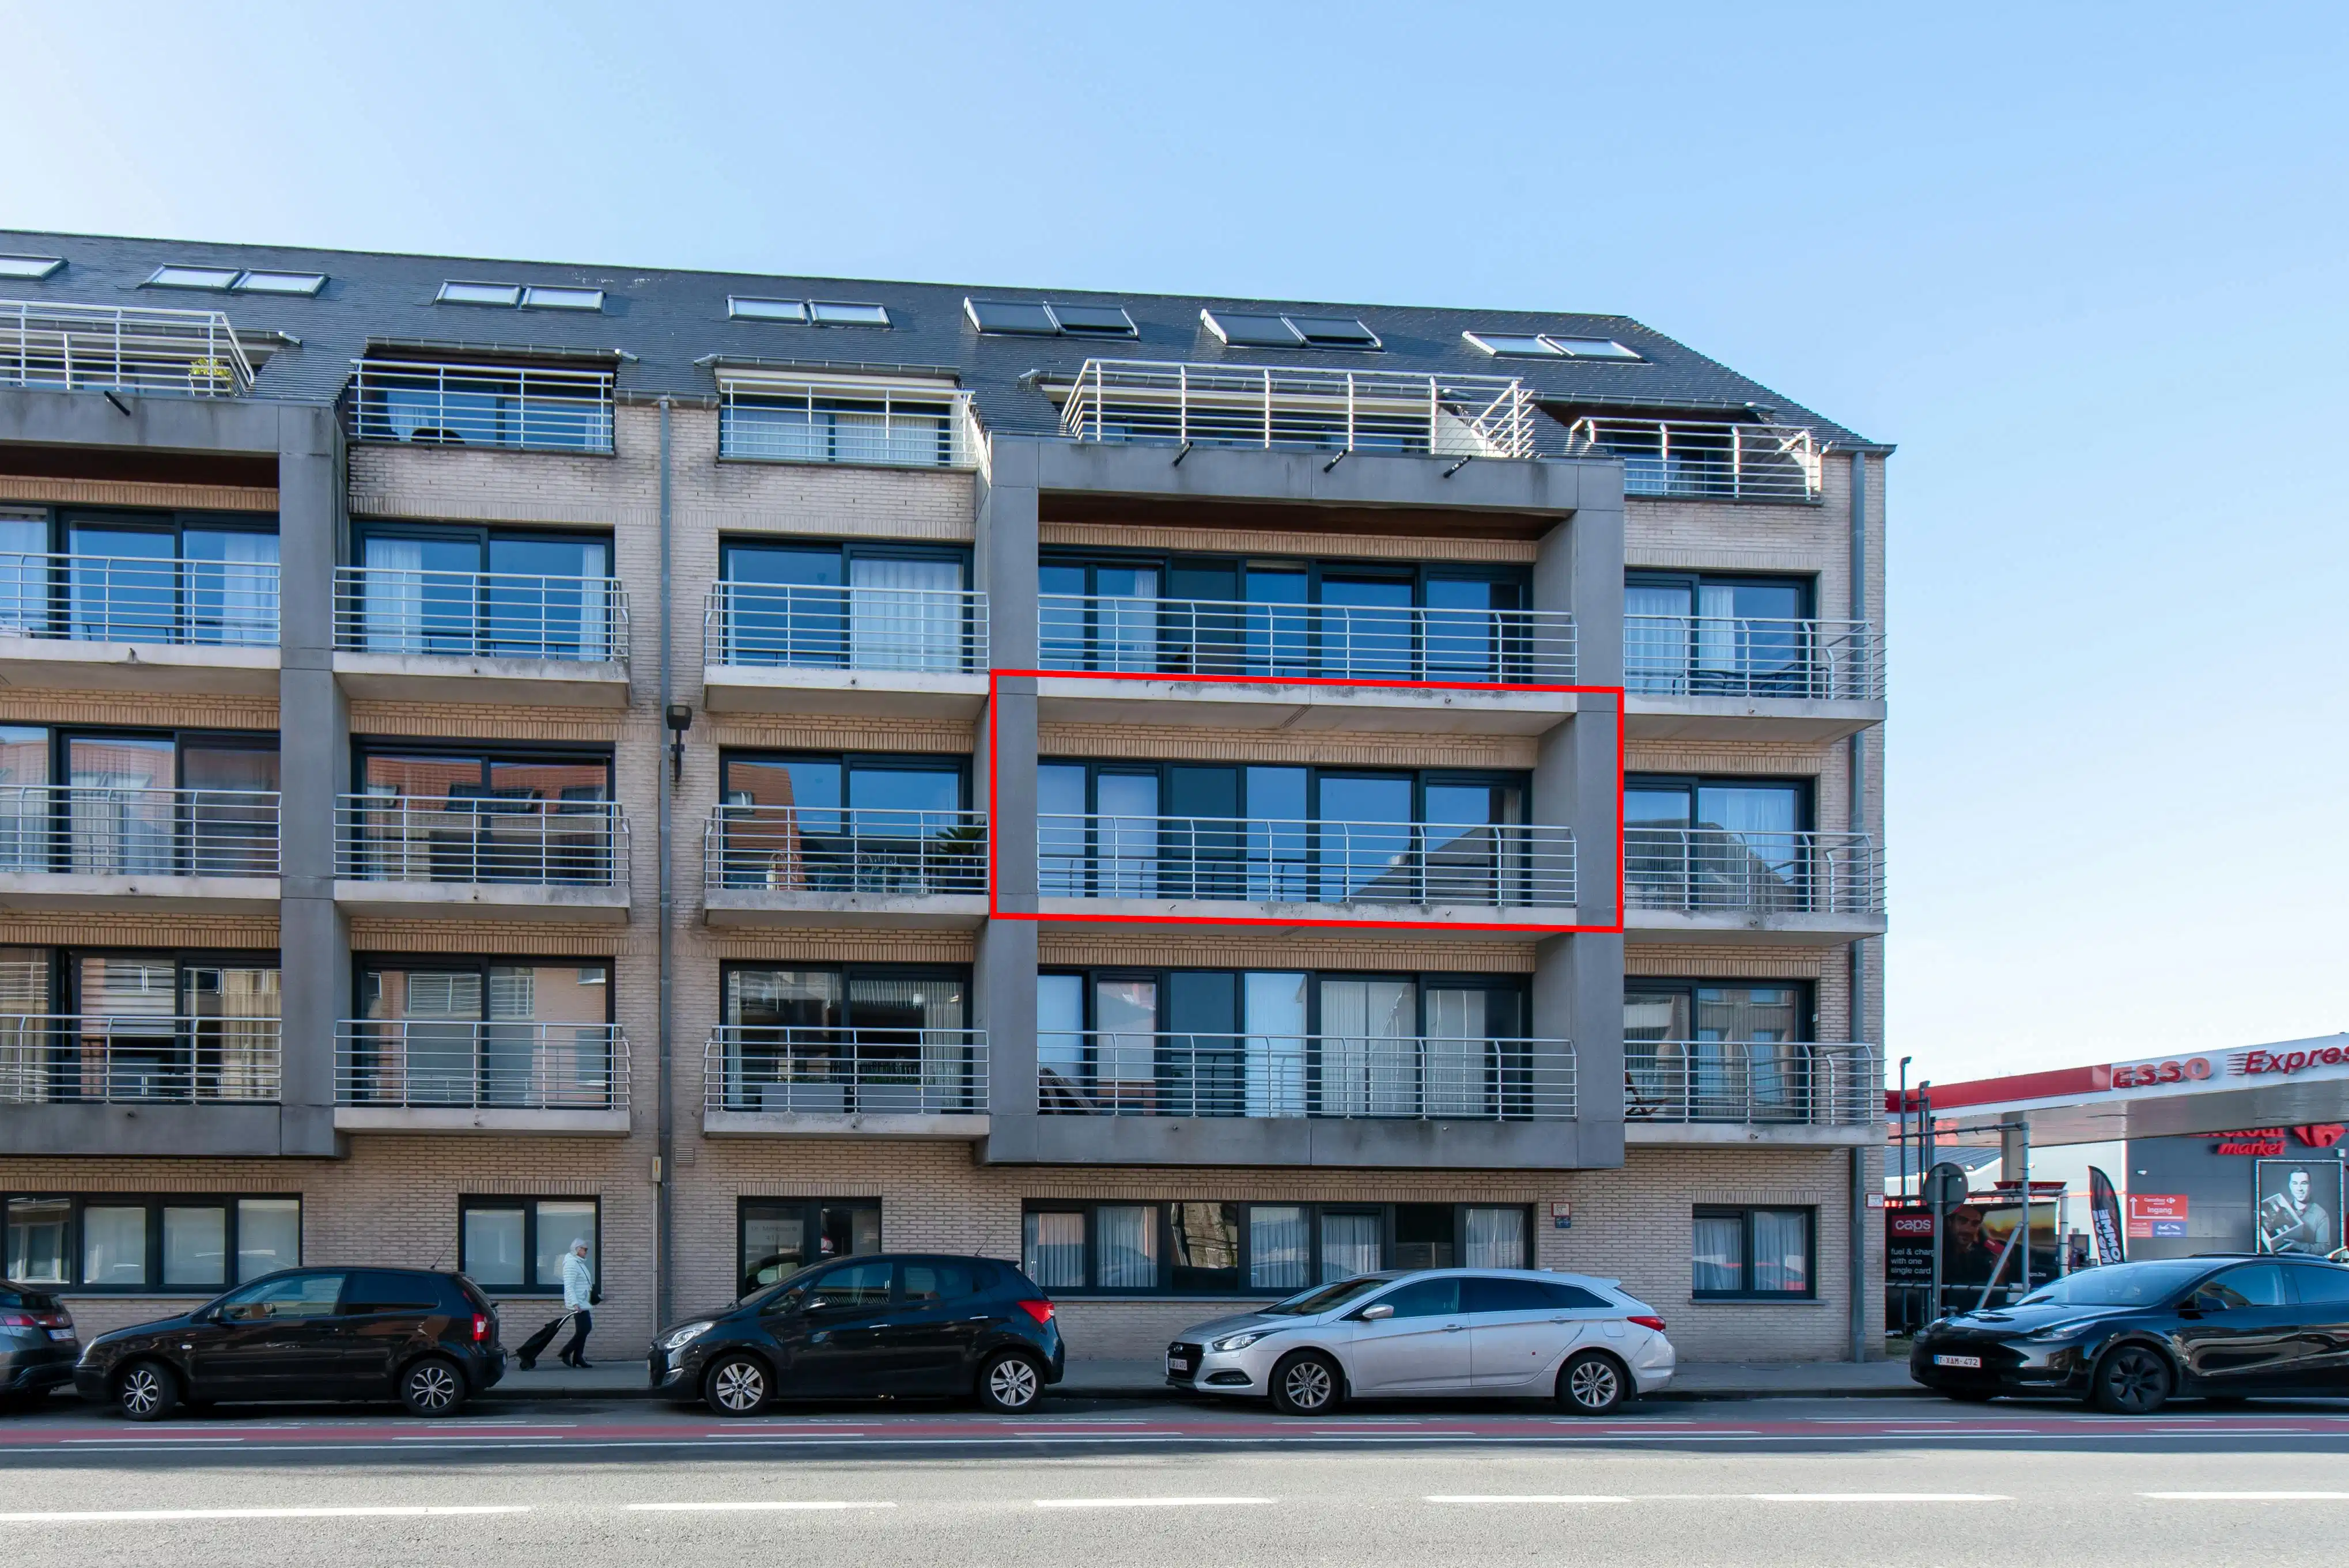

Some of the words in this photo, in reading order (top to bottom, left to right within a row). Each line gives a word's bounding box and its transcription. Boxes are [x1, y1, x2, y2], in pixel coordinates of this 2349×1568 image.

[2218, 1139, 2286, 1156] market
[2147, 1206, 2173, 1214] Ingang
[1895, 1219, 1931, 1232] caps
[1915, 1248, 1935, 1257] charg
[1891, 1267, 1913, 1275] single
